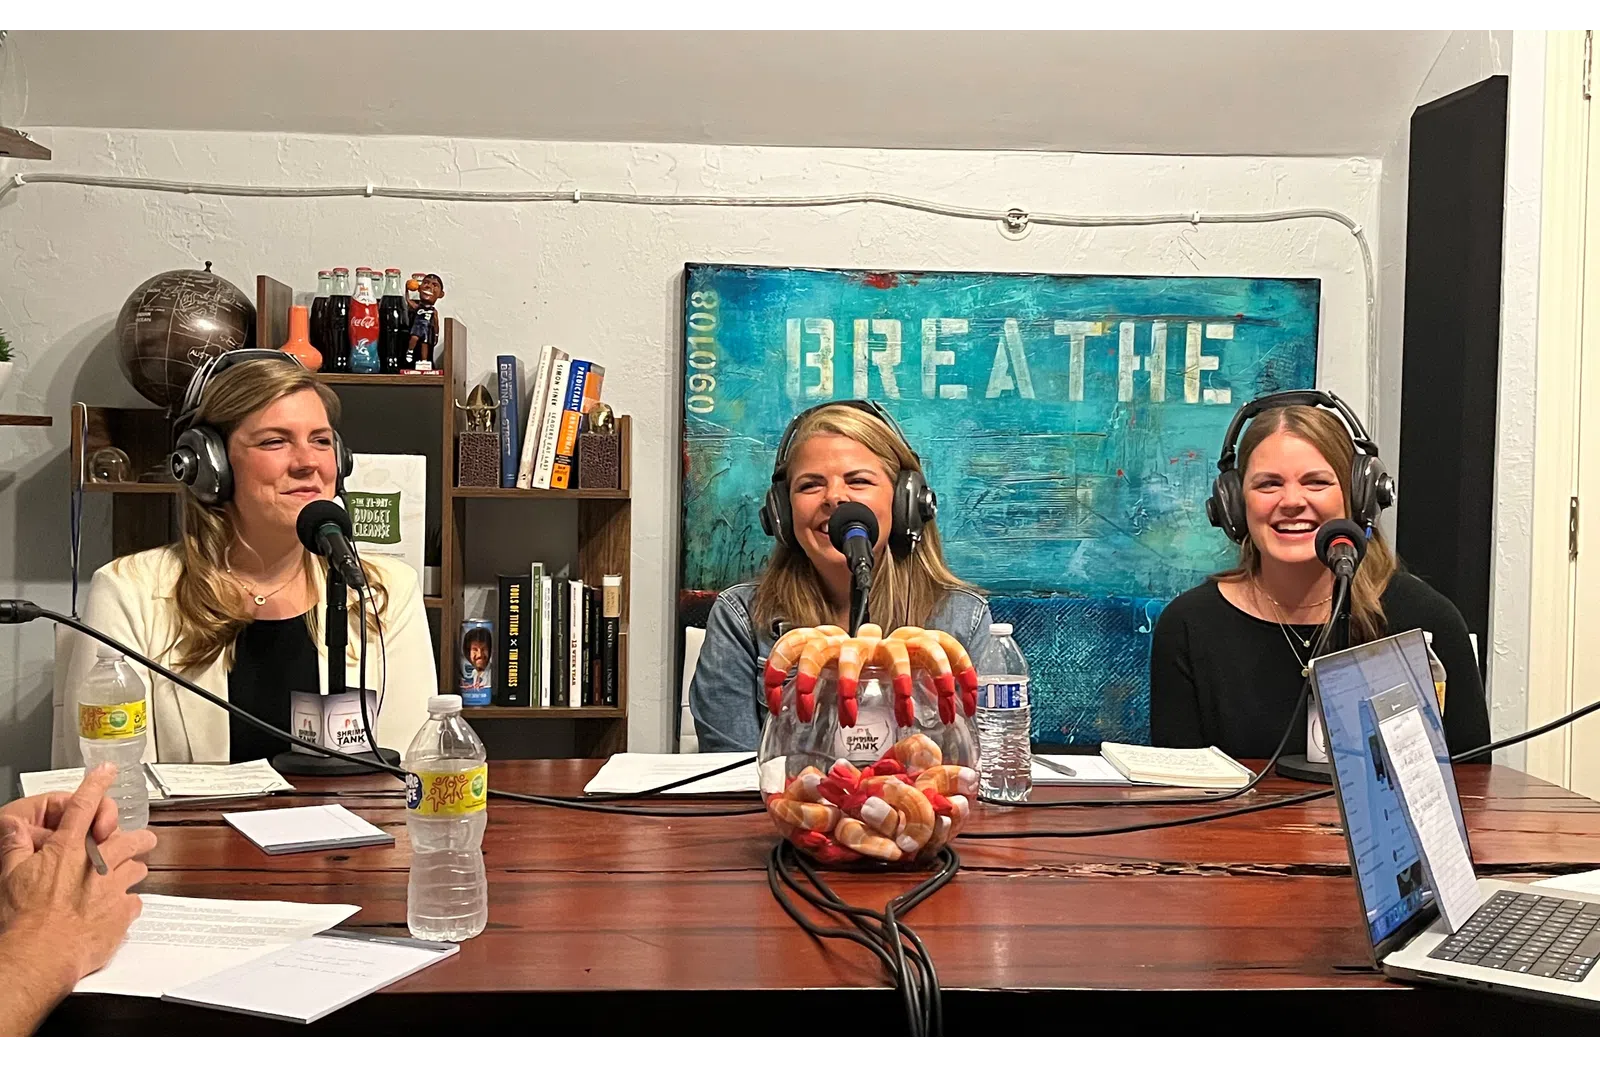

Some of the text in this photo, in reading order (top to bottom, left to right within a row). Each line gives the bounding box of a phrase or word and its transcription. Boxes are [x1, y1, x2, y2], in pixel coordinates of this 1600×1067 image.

[687, 289, 719, 414] 090108
[785, 317, 1236, 405] BREATHE
[500, 363, 509, 406] BEATING
[555, 364, 563, 385] SIMON
[552, 387, 560, 407] SINEK
[571, 366, 585, 411] PREDICTABLY
[549, 412, 557, 439] LEADERS
[564, 413, 577, 455] IRRATIONAL
[502, 418, 511, 456] STREET
[354, 508, 391, 523] BUDGET
[509, 584, 520, 604] TOOLS
[509, 605, 519, 613] OF
[509, 614, 519, 636] TITANS
[571, 639, 578, 648] 12
[509, 648, 519, 661] TIM
[508, 661, 518, 688] FERRISS
[337, 728, 366, 738] SHRIMP
[337, 735, 366, 746] TANK
[846, 742, 879, 752] TANK
